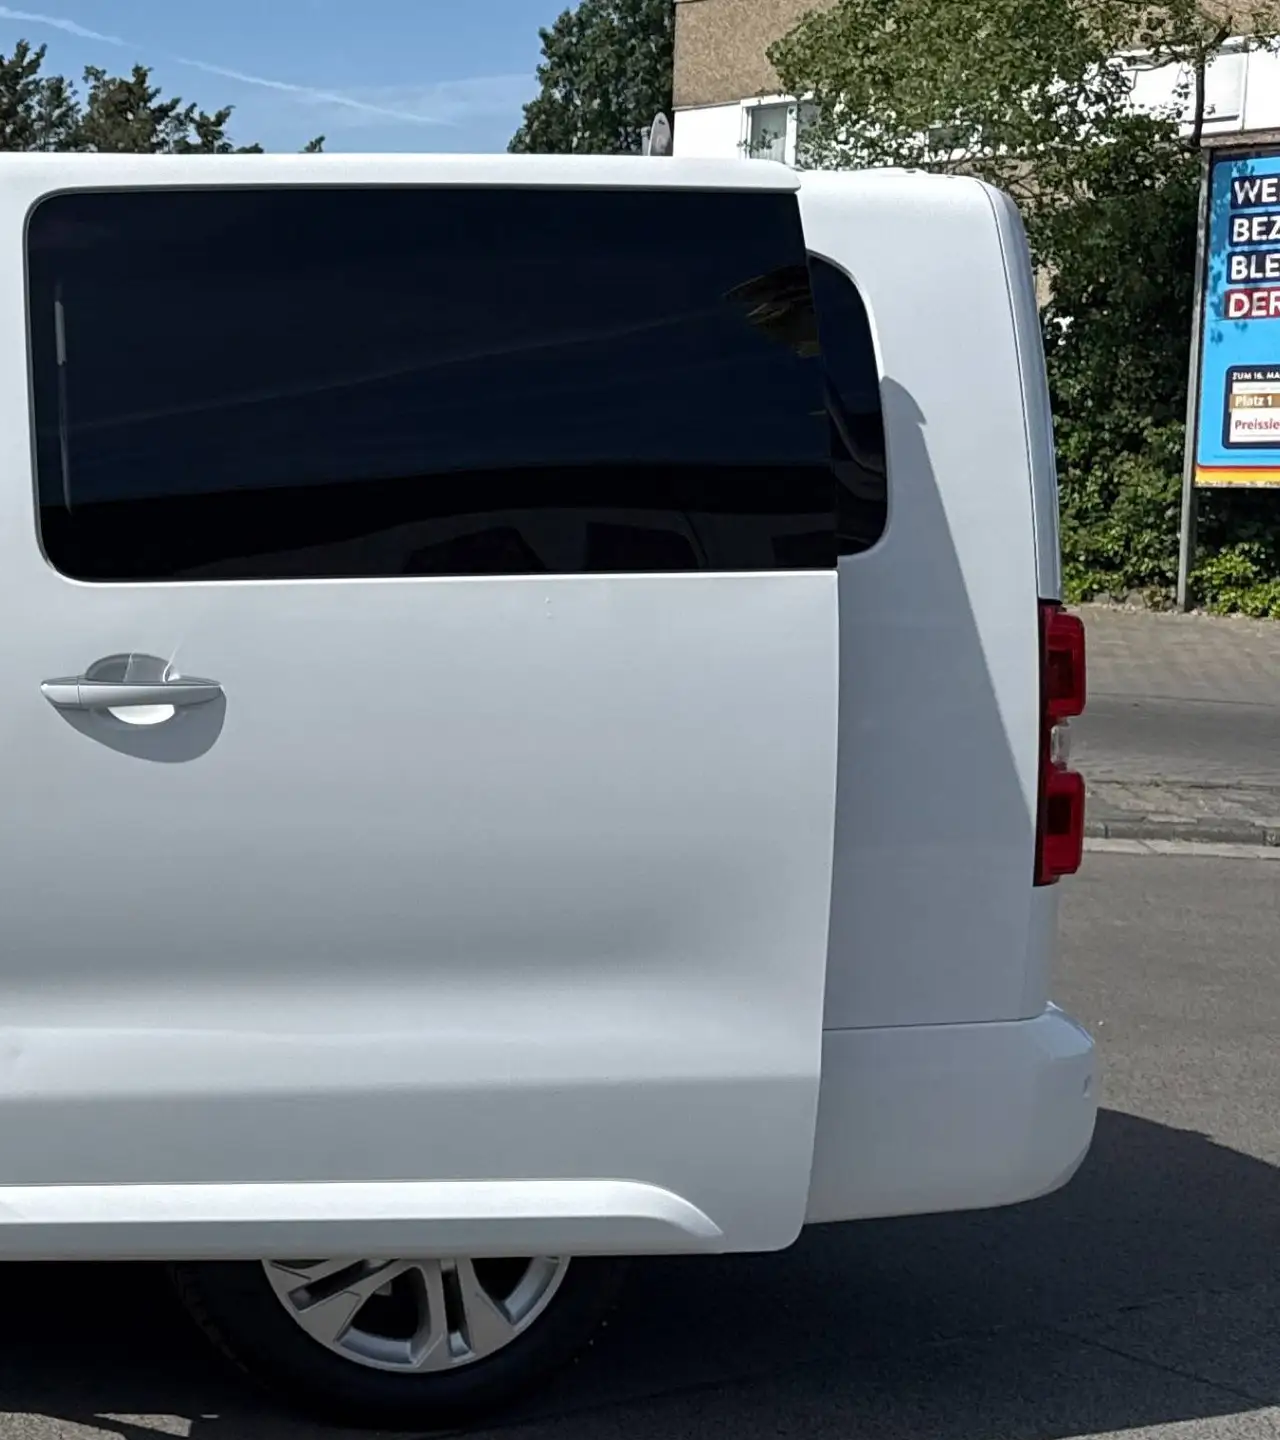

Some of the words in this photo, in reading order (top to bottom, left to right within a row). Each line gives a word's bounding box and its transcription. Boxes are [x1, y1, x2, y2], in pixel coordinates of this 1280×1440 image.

[1230, 253, 1280, 281] BLE
[1228, 290, 1280, 318] DER
[1232, 371, 1252, 381] ZUM
[1235, 395, 1264, 407] Platz
[1266, 395, 1273, 407] 1
